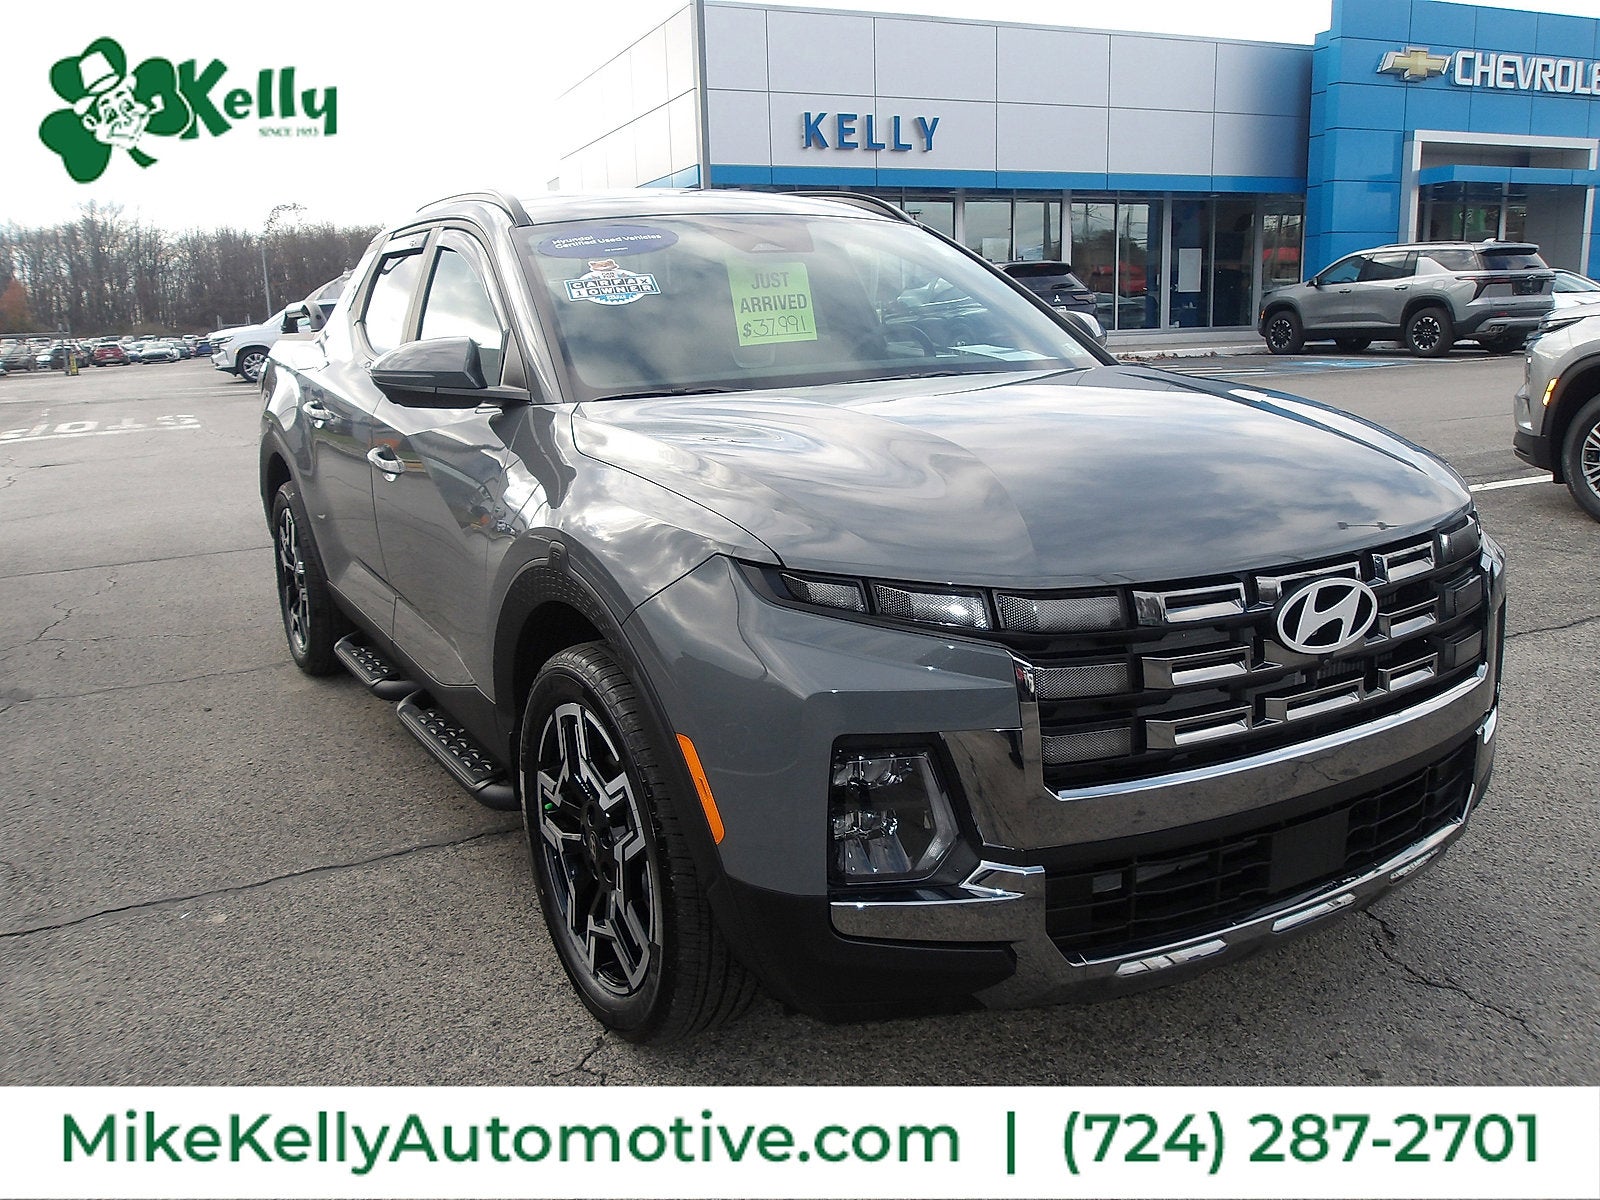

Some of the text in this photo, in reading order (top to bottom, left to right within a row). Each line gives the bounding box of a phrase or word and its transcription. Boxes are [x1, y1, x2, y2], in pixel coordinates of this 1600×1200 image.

[802, 112, 940, 152] KELLY
[551, 235, 594, 245] Hyundai
[555, 239, 597, 249] Certified
[597, 236, 623, 244] Used
[622, 233, 662, 241] Vehicles
[571, 278, 649, 289] CARFAX
[751, 271, 790, 290] JUST
[587, 284, 655, 296] OWNER
[740, 293, 808, 314] ARRIVED
